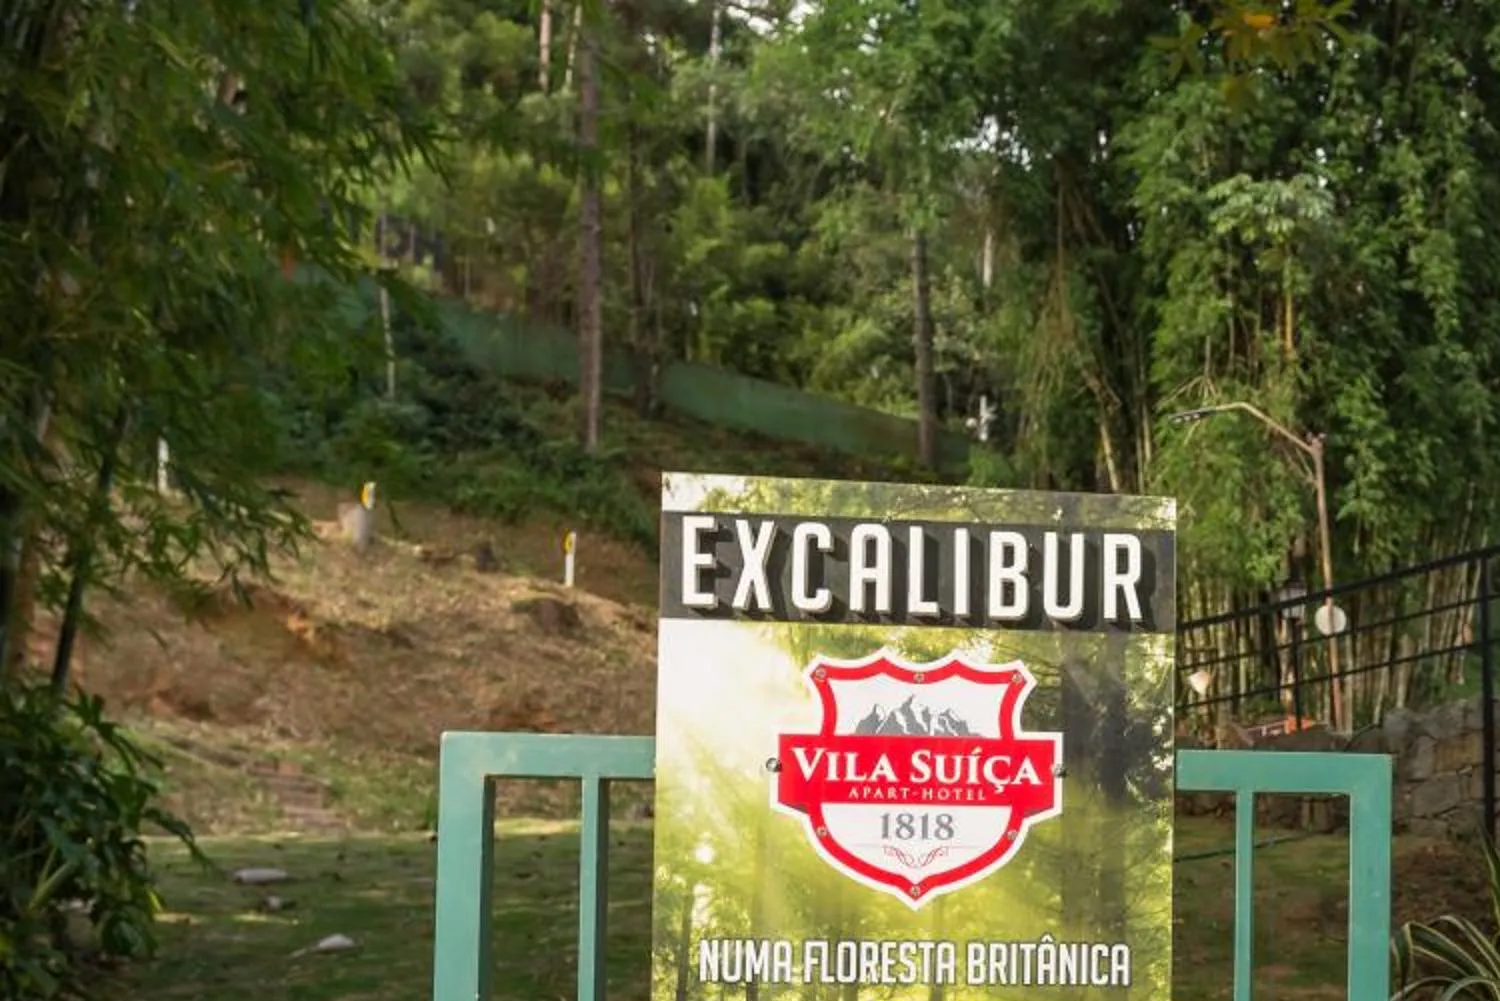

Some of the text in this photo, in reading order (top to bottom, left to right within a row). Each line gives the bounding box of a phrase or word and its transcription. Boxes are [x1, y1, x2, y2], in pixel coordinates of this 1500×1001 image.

[681, 515, 1143, 621] EXCALIBUR
[793, 746, 1043, 793] VILA SUÍÇA
[848, 786, 987, 801] APART-HOTEL
[879, 812, 954, 840] 1818
[699, 935, 1131, 987] NUMA FLORESTA BRITÂNICA
